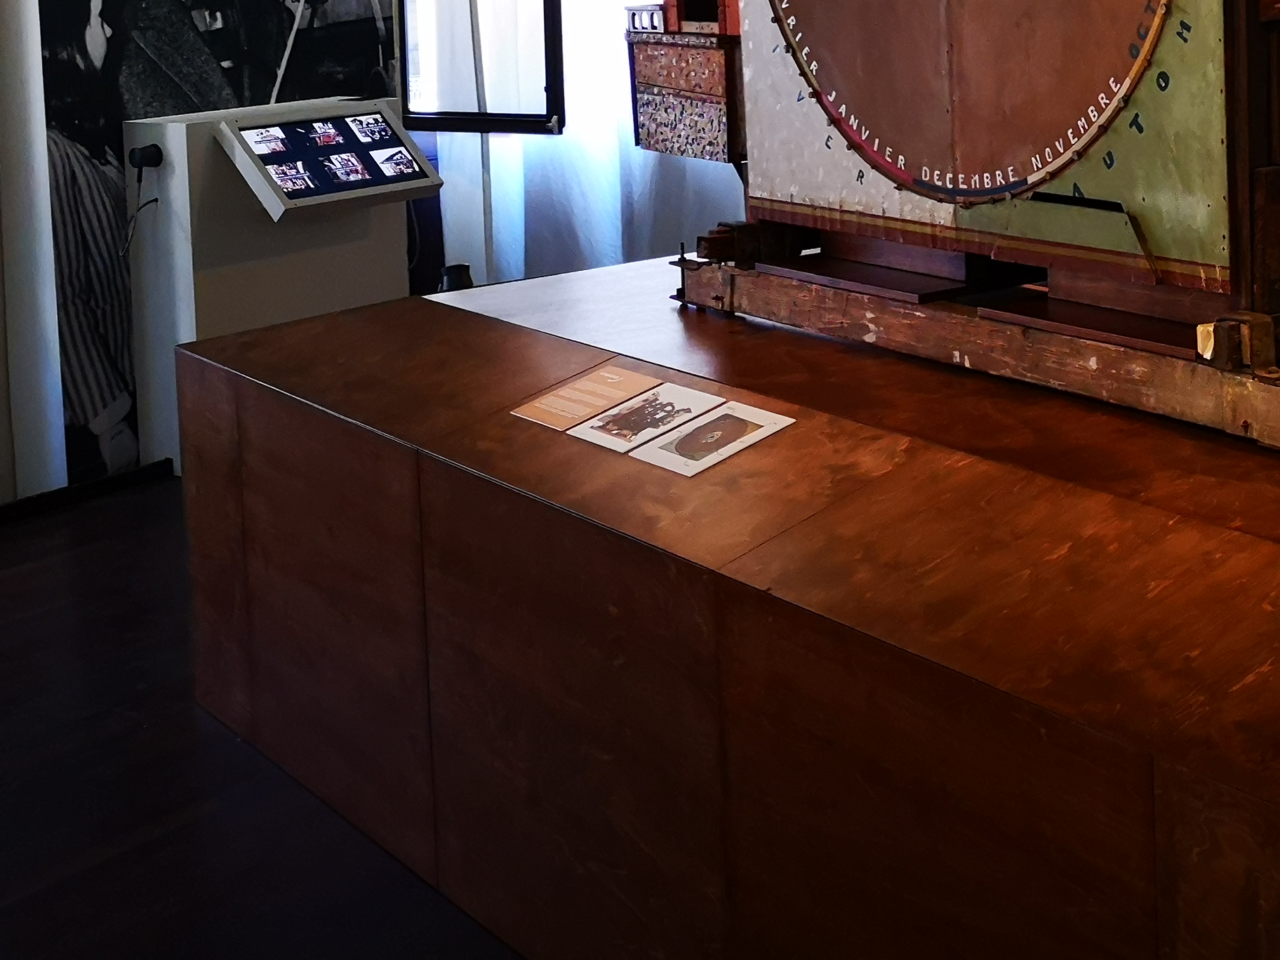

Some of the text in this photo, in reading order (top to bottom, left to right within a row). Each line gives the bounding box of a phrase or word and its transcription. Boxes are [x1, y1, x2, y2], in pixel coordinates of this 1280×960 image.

[827, 90, 906, 170] JANVIER
[1031, 77, 1121, 171] NOVEMBRE
[922, 165, 1018, 189] DECEMBRE
